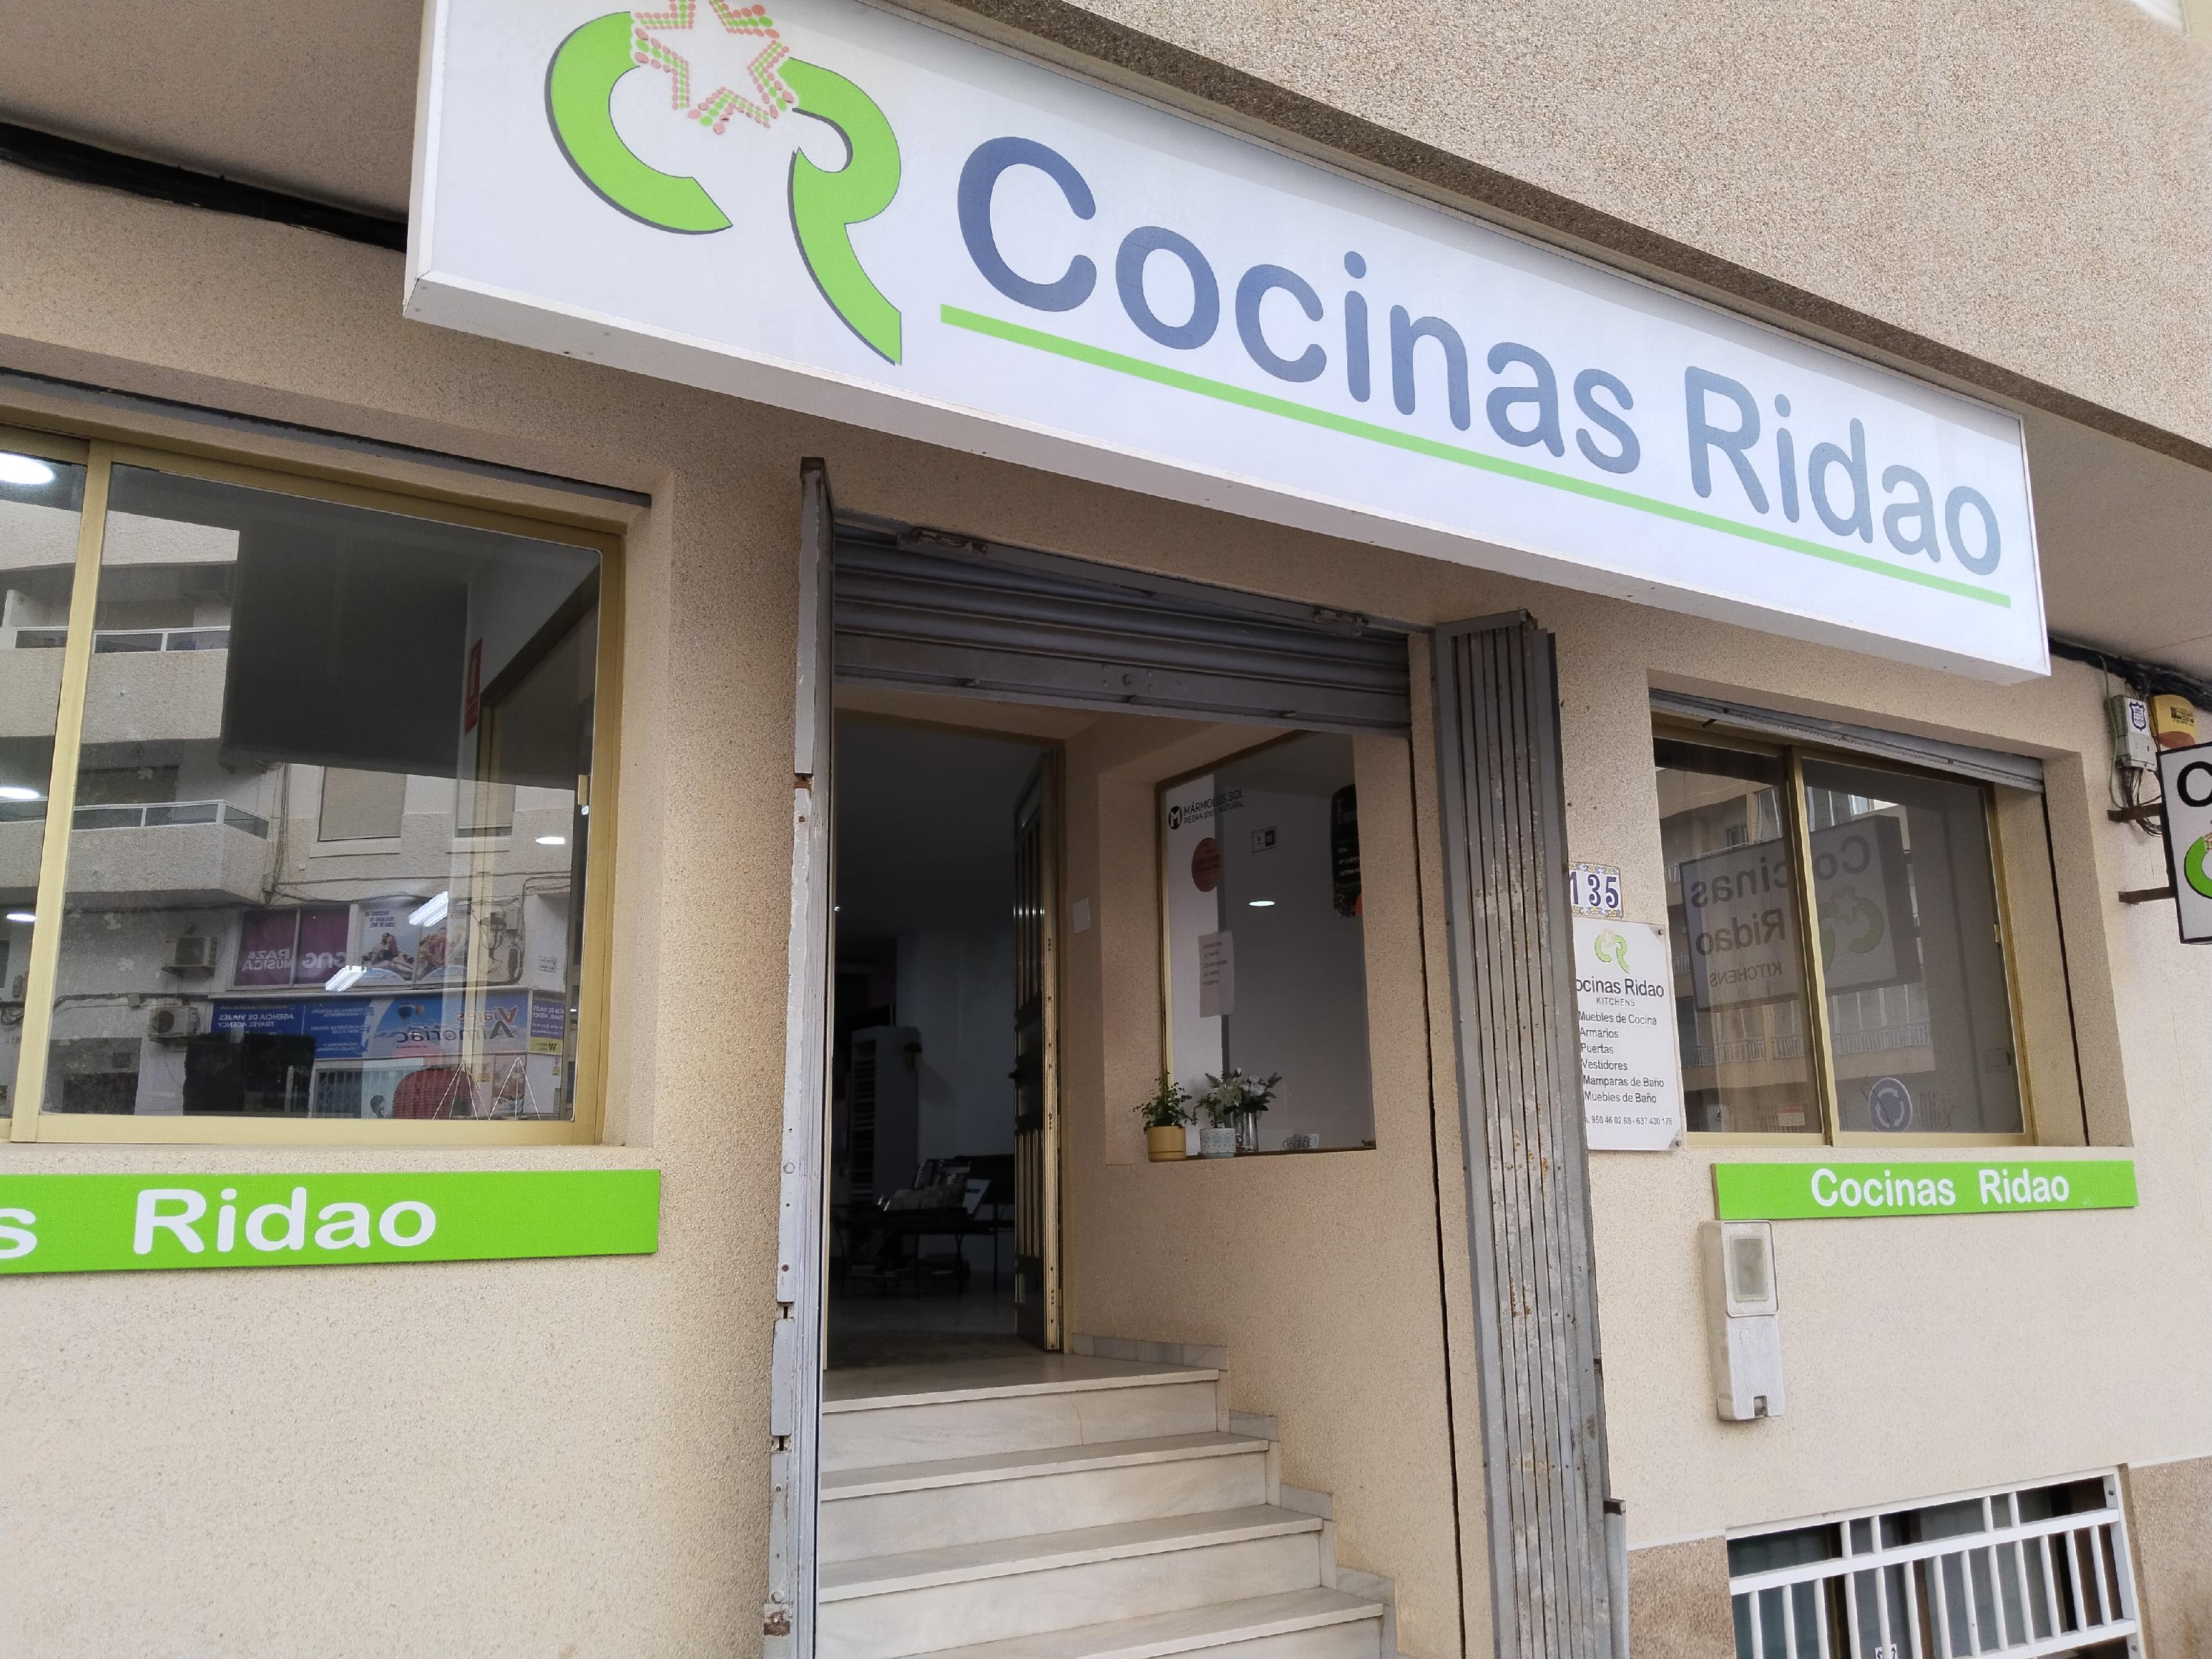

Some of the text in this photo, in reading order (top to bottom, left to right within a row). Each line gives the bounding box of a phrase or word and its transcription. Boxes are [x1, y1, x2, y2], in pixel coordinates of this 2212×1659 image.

[957, 136, 2000, 576] Cocinas Ridao
[1228, 788, 1244, 801] SOL
[1576, 976, 1664, 997] ocinas Ridao
[1596, 997, 1635, 1007] KITCHENS
[1578, 1011, 1657, 1025] Muebles de Cocina
[1580, 1027, 1619, 1038] Armarios
[1581, 1043, 1614, 1054] Puertas
[1582, 1058, 1628, 1071] Vestidores
[1583, 1075, 1665, 1088] Mamparas de Baño
[1584, 1091, 1657, 1103] Muebles de Baño
[1591, 1115, 1604, 1124] 950
[1605, 1116, 1613, 1125] 46
[1614, 1116, 1622, 1125] 02
[1636, 1117, 1647, 1125] 637
[1811, 1168, 2069, 1207] Cocinas Ridao
[133, 1186, 436, 1255] Ridao
